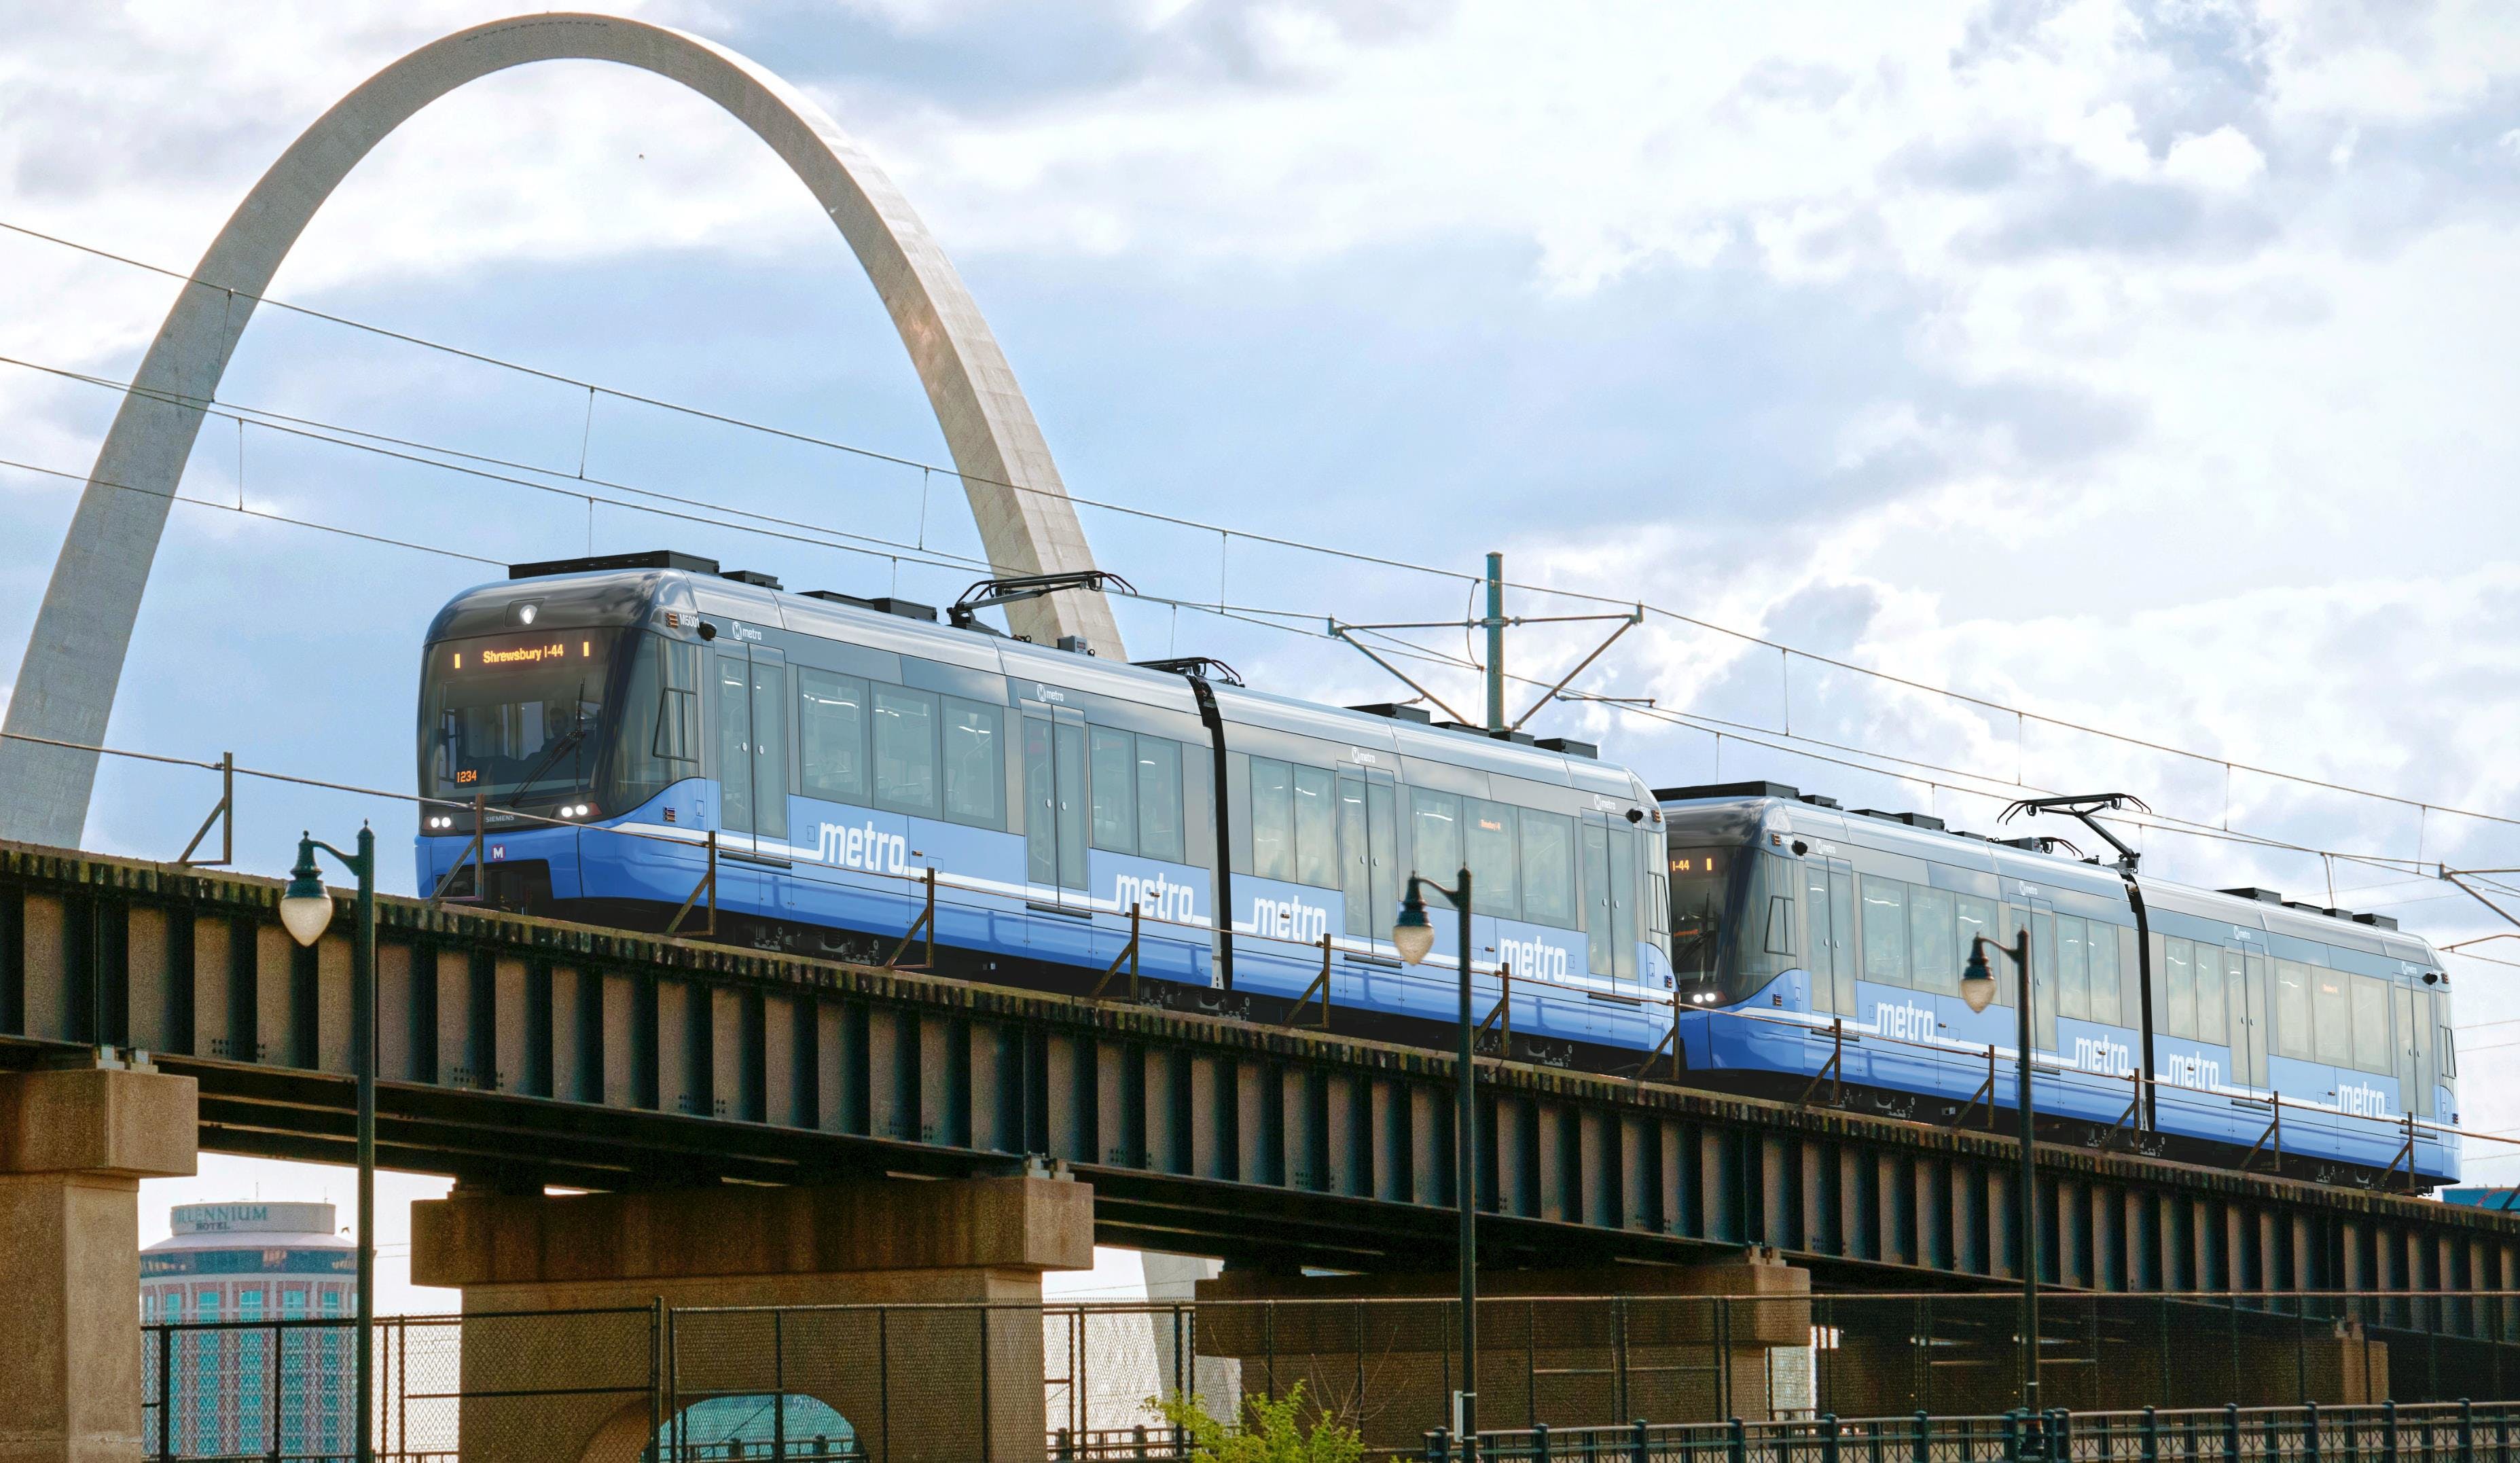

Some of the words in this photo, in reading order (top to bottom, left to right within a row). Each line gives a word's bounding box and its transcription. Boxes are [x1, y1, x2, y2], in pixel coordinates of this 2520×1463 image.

[679, 613, 700, 629] M5001
[742, 628, 761, 640] metro
[483, 647, 542, 663] Shrewsbury
[544, 644, 564, 658] I-44
[1046, 690, 1064, 702] metro
[1360, 753, 1375, 763] metro
[456, 770, 477, 782] 1234
[493, 846, 503, 859] M
[818, 820, 905, 875] metro
[1672, 859, 1689, 871] I-44
[1115, 872, 1193, 924] metro
[1253, 895, 1327, 943] metro
[1499, 935, 1566, 982] metro
[1876, 999, 1934, 1043] metro
[2075, 1034, 2128, 1076] metro
[2168, 1051, 2219, 1092] metro
[2338, 1081, 2385, 1119] metro
